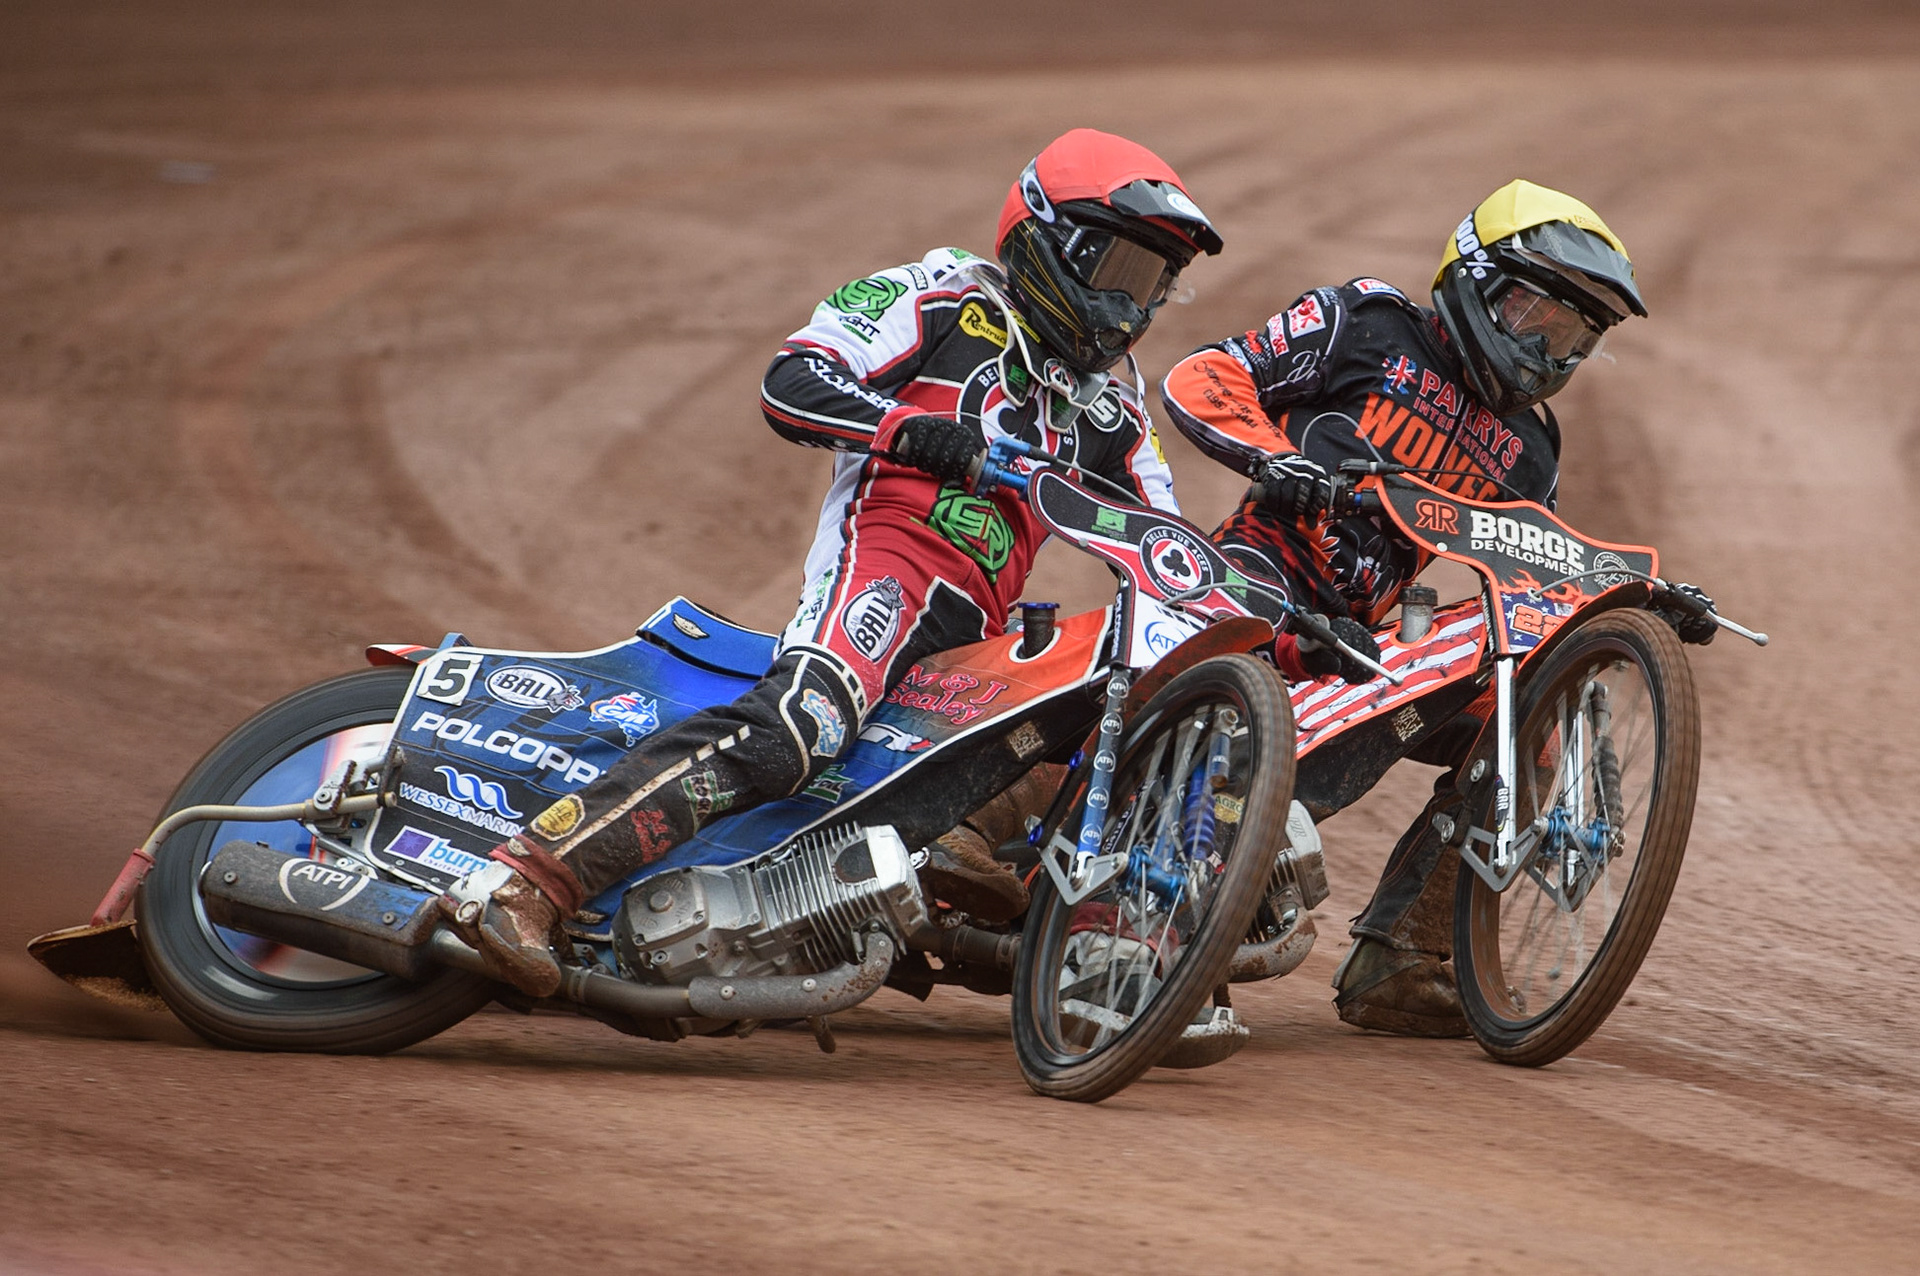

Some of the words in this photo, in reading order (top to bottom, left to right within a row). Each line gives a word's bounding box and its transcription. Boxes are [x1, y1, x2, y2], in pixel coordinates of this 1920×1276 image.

[965, 307, 1007, 344] Rentruc
[1145, 529, 1169, 546] BELLE
[1171, 531, 1191, 547] VUE
[1191, 548, 1209, 572] ACES
[1470, 509, 1585, 572] BORGE
[427, 658, 470, 698] 5
[902, 663, 944, 688] M
[939, 673, 980, 693] &
[968, 680, 1009, 705] J
[884, 682, 983, 725] Sealey
[411, 711, 607, 784] POLCOPP
[400, 782, 526, 837] WESSEXMARIN
[291, 864, 355, 890] ATPI
